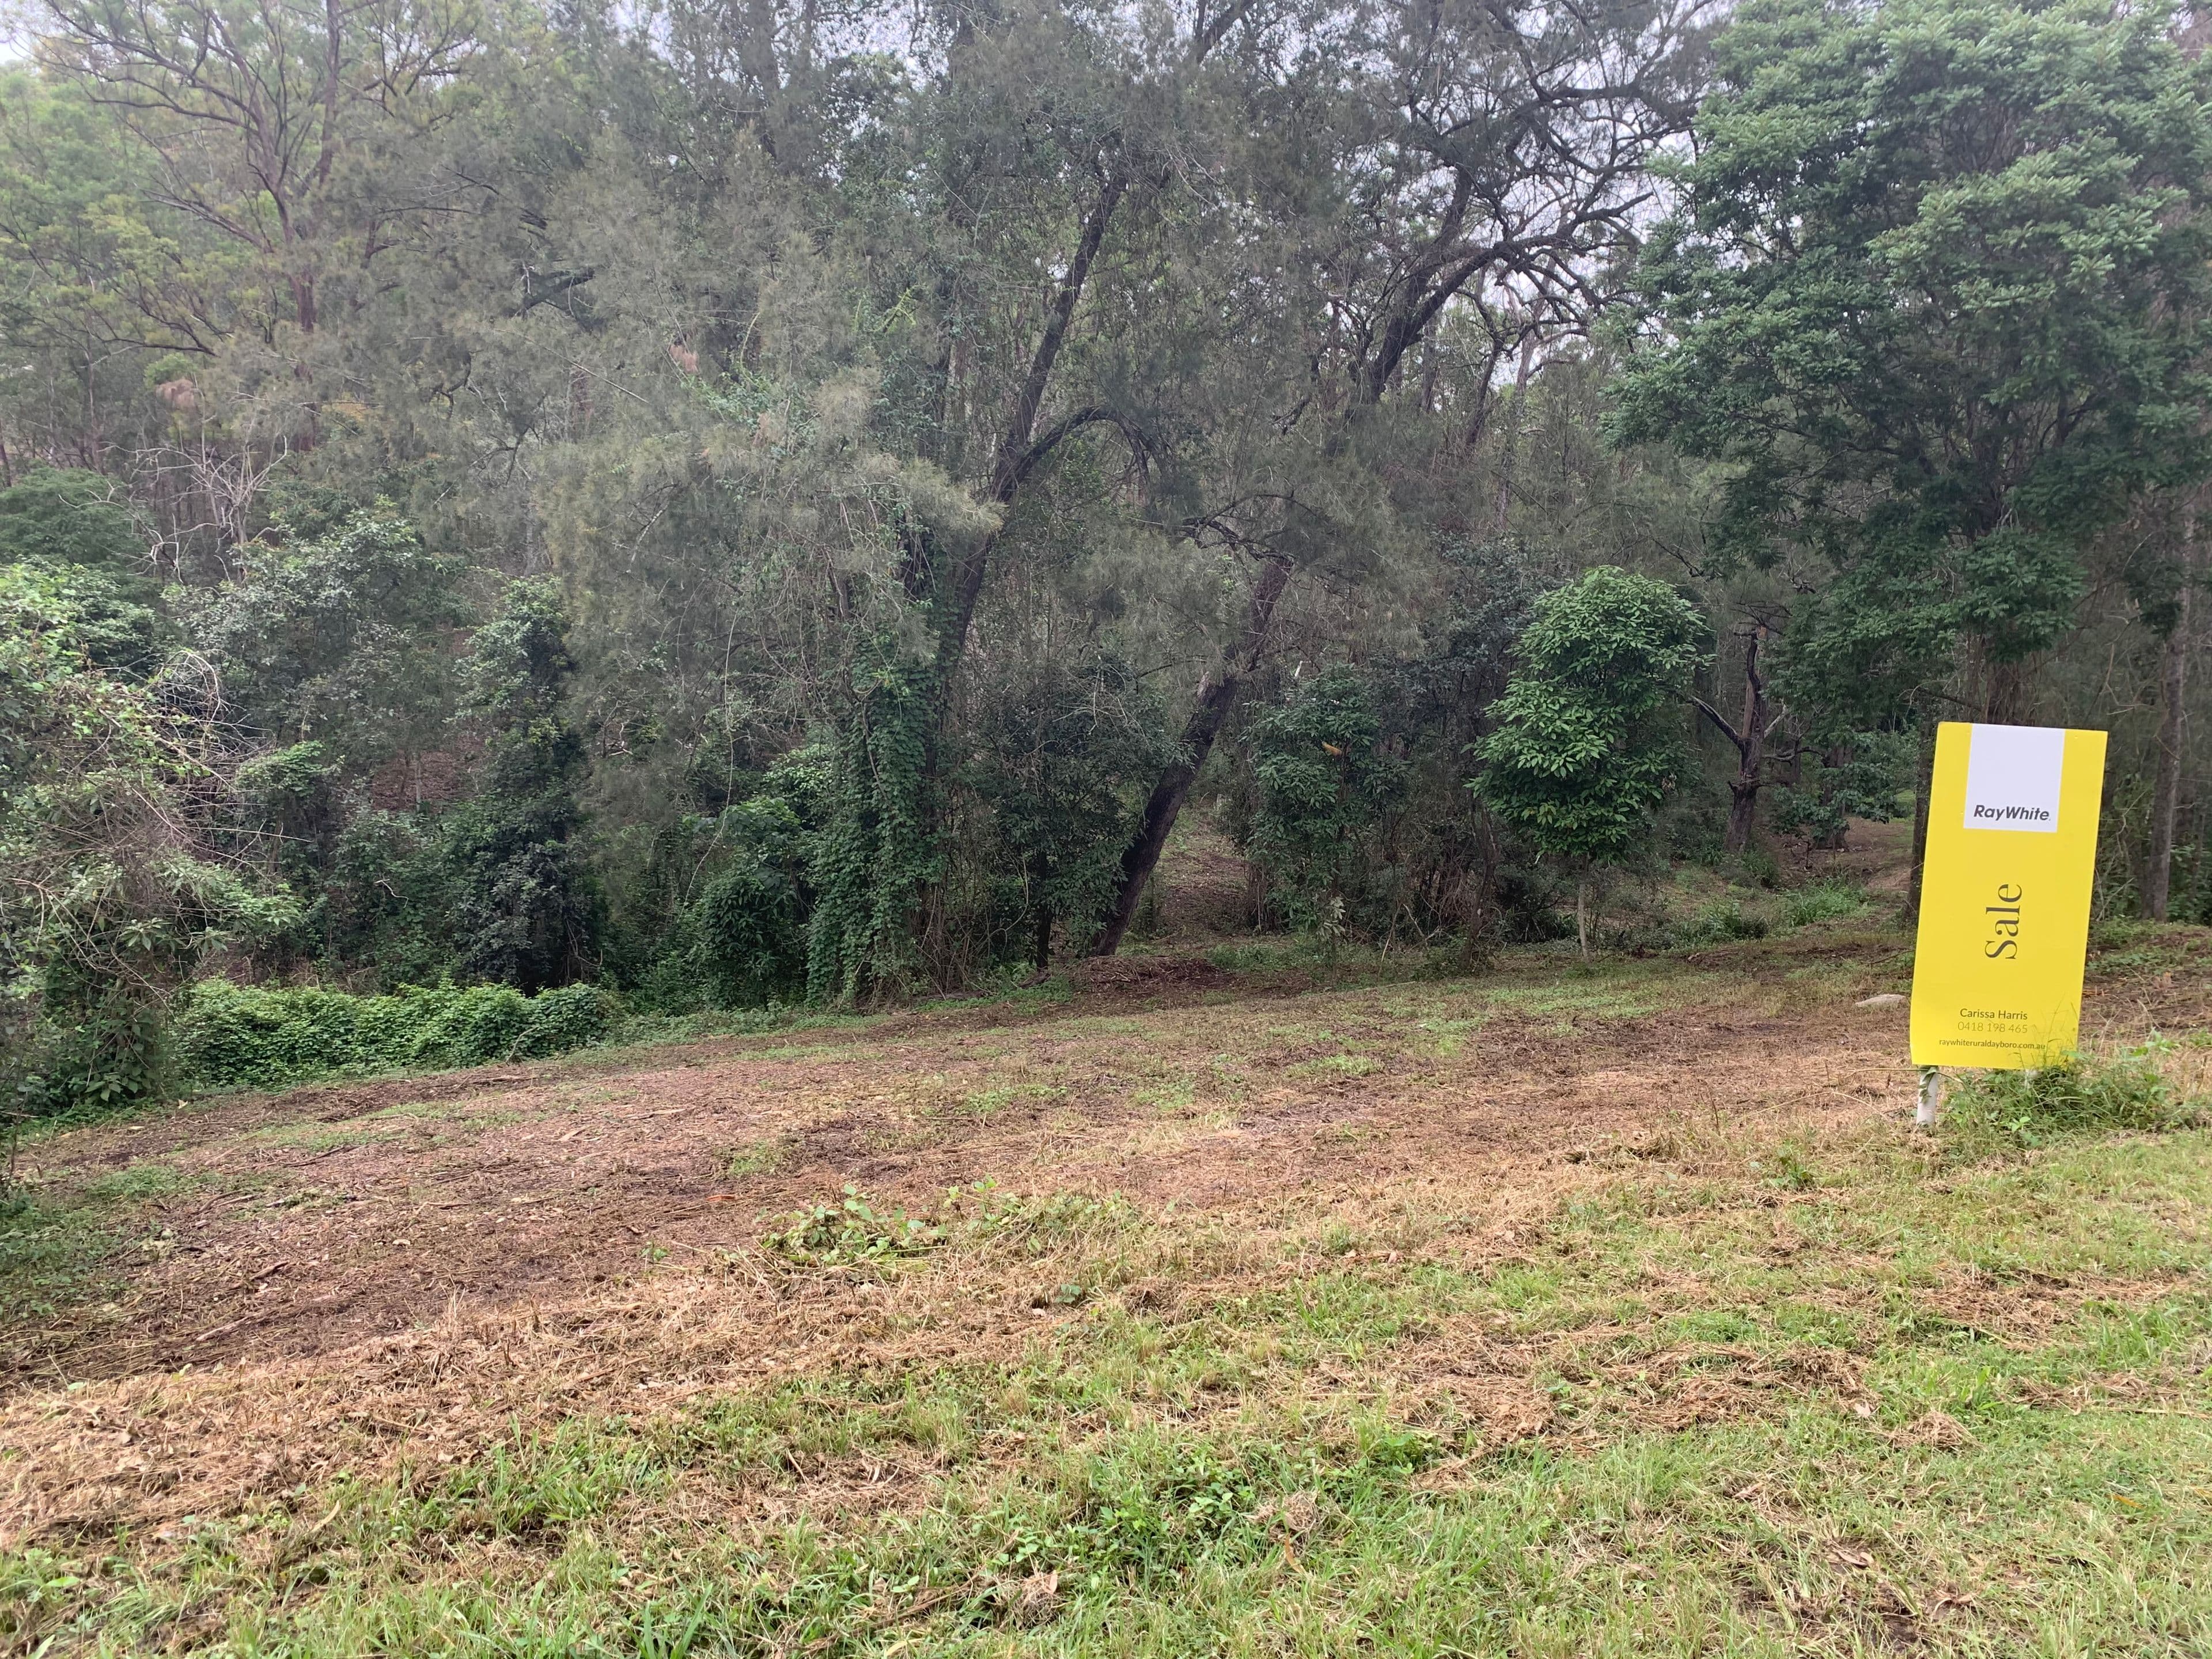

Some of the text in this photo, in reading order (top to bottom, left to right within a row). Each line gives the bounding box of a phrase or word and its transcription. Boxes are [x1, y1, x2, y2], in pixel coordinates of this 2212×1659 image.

[1984, 884, 2022, 960] Sale
[1960, 1008, 2028, 1020] Carissa Harris
[1957, 1021, 2028, 1033] 0418 198 465
[1939, 1039, 2046, 1050] raywhiteruraldayboro.com.au
